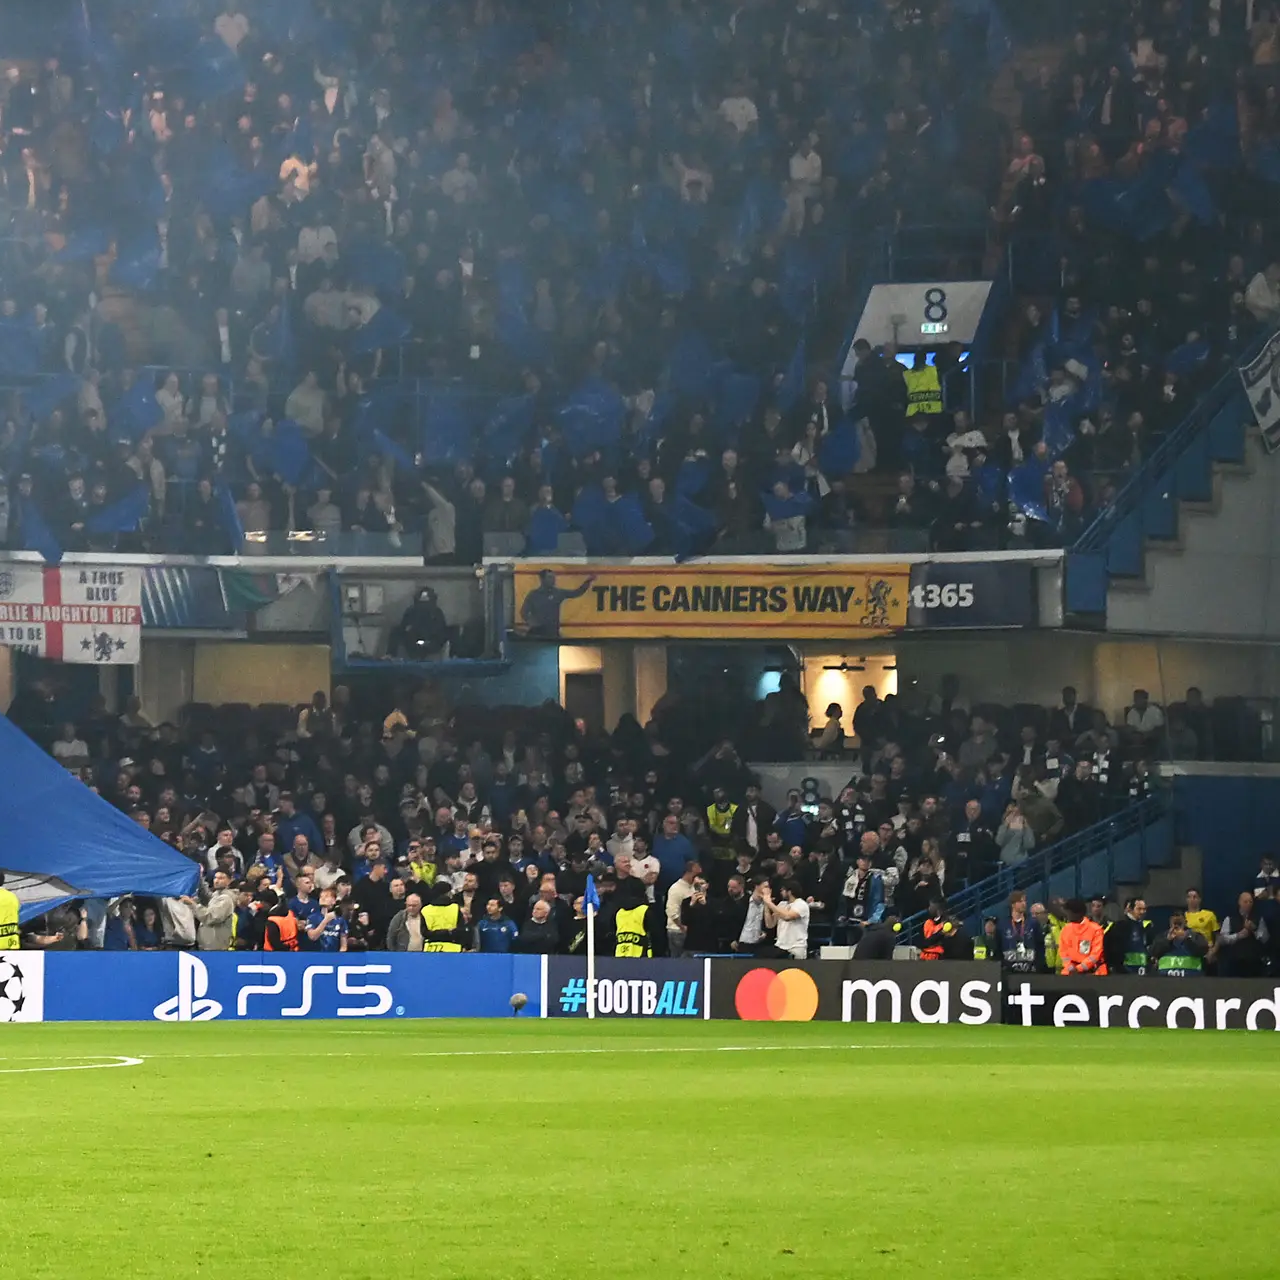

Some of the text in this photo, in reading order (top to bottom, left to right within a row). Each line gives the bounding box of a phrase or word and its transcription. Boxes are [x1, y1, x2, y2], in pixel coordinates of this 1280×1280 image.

[924, 287, 948, 323] 8
[592, 585, 856, 613] THE CANNERS WAY
[112, 606, 137, 624] RIP
[8, 625, 23, 641] TO
[28, 626, 43, 641] BE
[237, 964, 393, 1016] PS5
